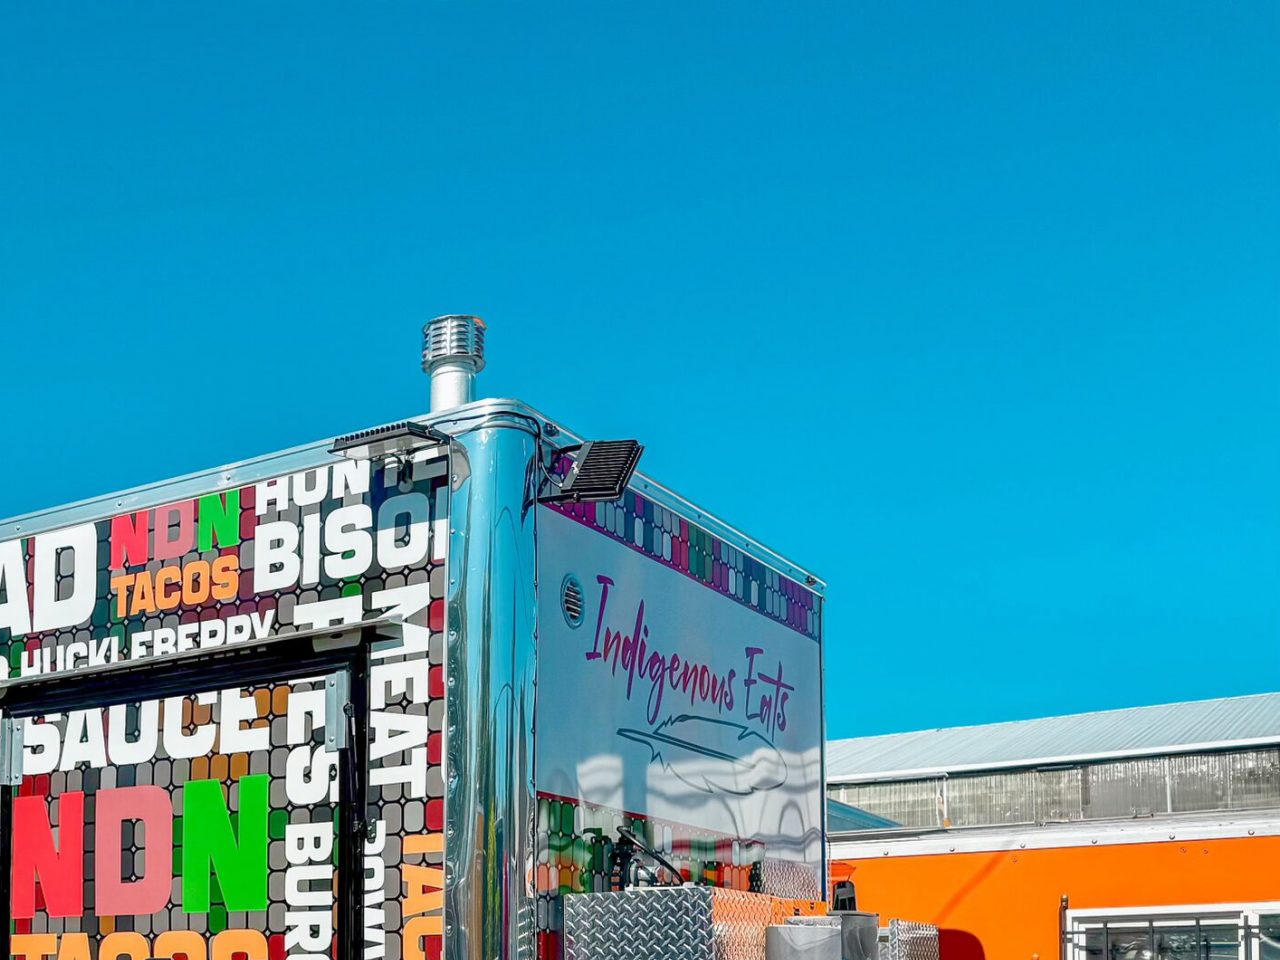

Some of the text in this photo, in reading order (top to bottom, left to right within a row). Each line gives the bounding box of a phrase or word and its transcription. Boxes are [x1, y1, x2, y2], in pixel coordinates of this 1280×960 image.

[110, 489, 241, 571] NDN
[110, 554, 240, 618] TACOS
[369, 582, 430, 799] MEAT
[585, 574, 795, 743] Indigenous Eats
[22, 687, 270, 776] SAUCE
[11, 773, 270, 920] NDN
